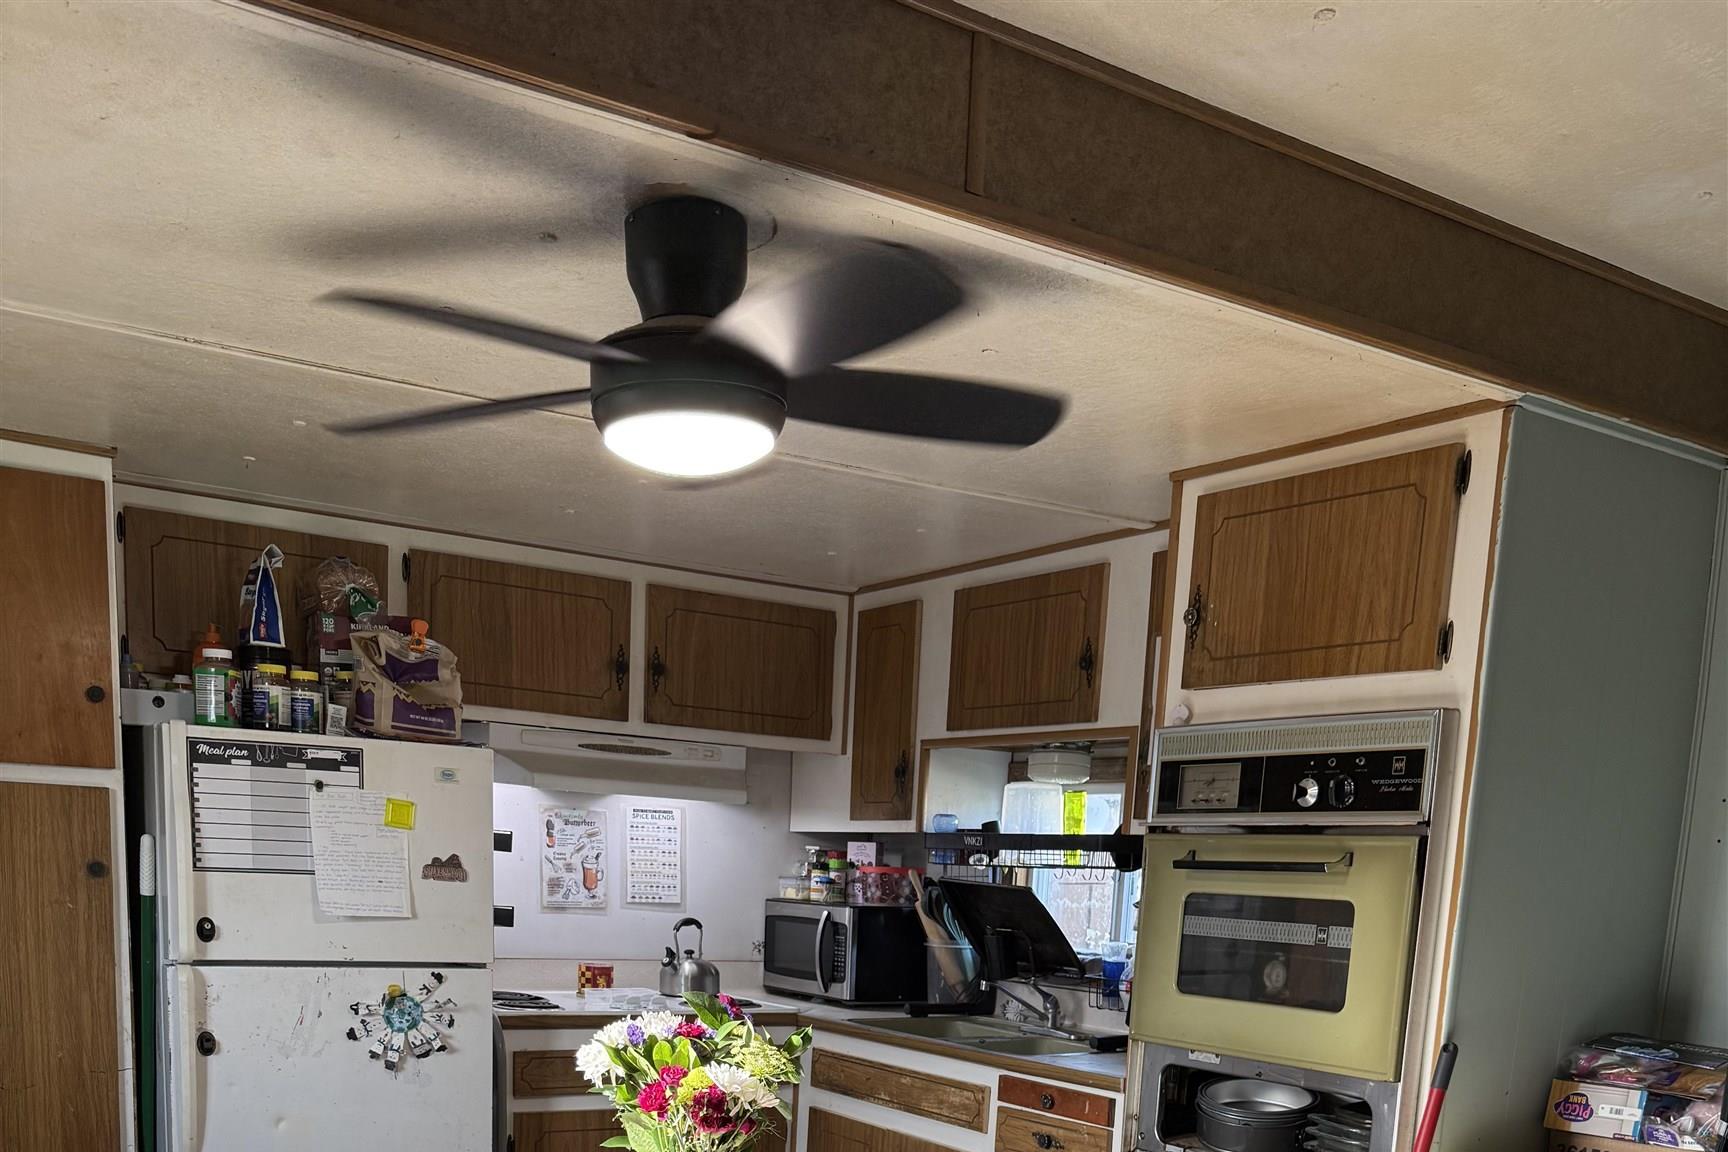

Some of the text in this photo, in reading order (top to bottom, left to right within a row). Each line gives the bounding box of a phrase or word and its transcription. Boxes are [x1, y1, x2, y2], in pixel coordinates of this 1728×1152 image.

[196, 743, 249, 758] Meal plan
[651, 813, 675, 821] BLENDS
[963, 835, 983, 846] VNKZI
[1568, 1095, 1586, 1104] BANK
[1557, 1101, 1592, 1119] PIGGY
